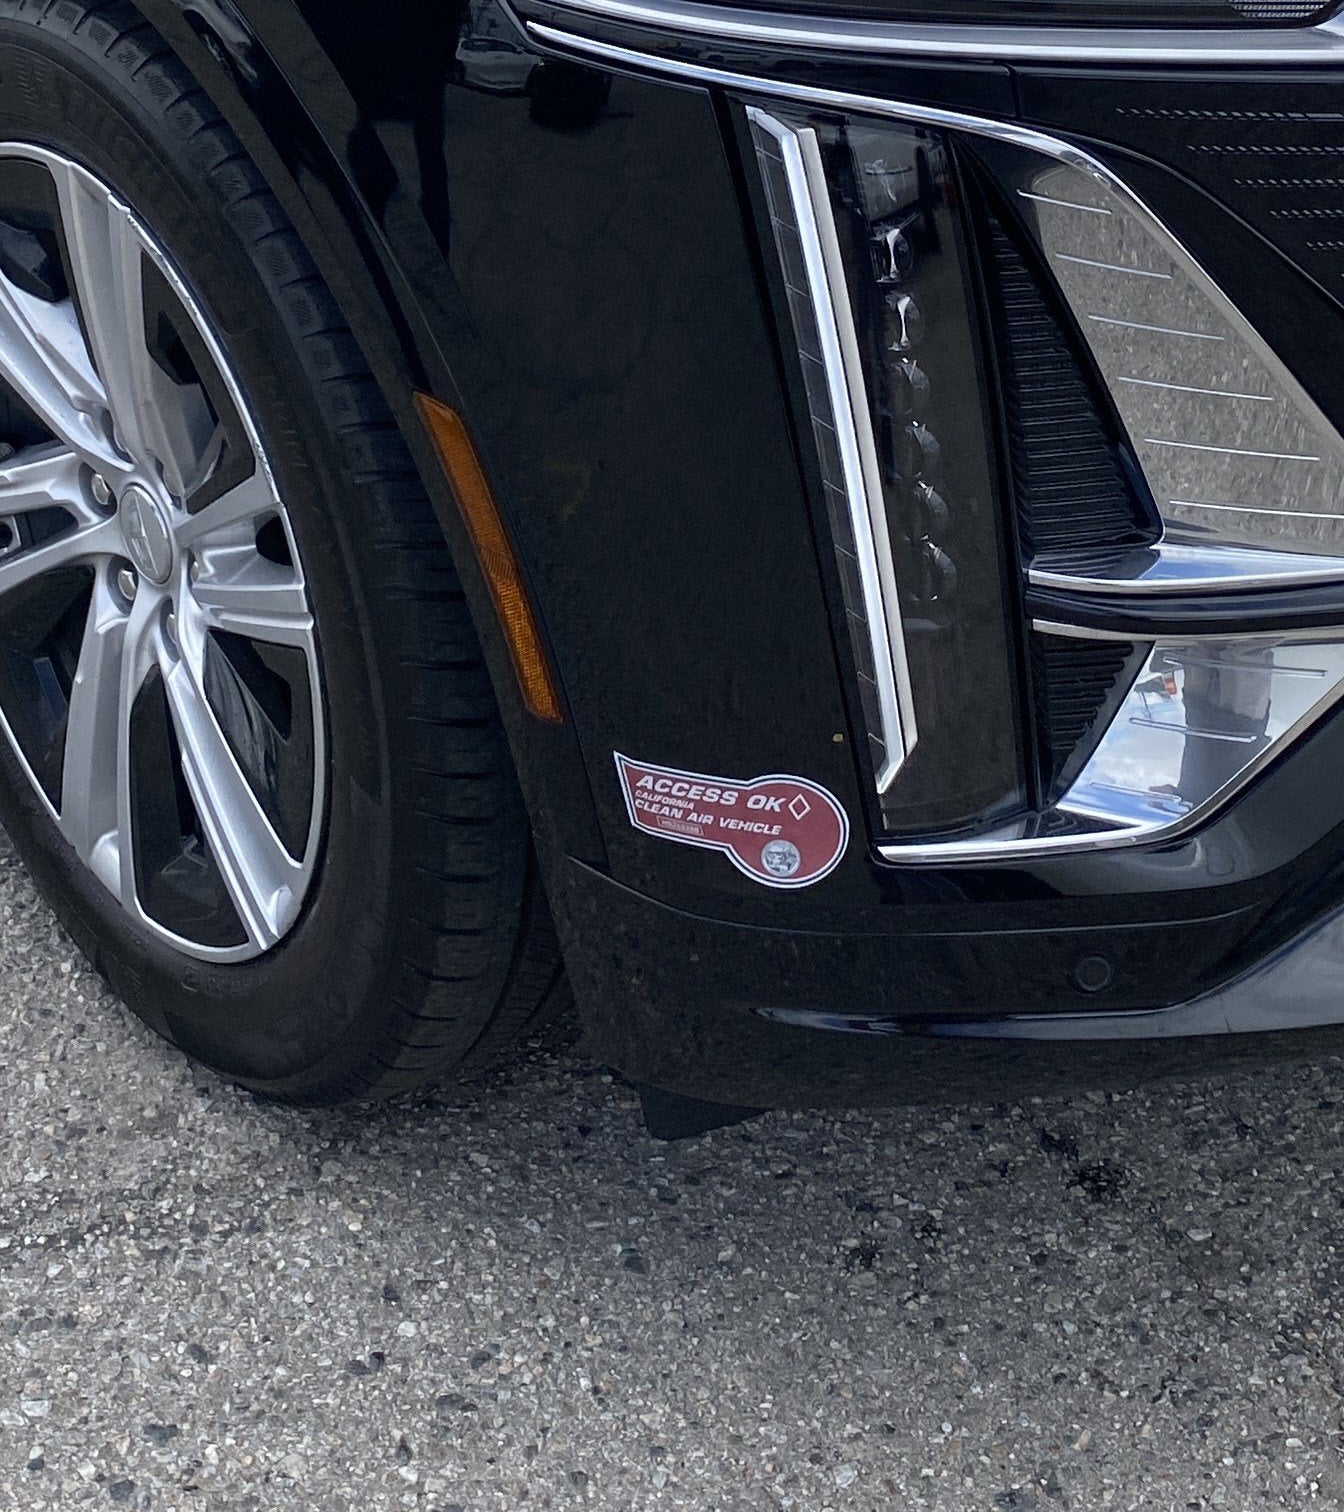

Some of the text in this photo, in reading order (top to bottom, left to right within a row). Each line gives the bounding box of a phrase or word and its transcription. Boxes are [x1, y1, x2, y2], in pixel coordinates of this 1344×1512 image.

[635, 775, 787, 813] ACCESS OK
[635, 789, 695, 810] CALIFORNIA
[635, 798, 684, 819] CLEAN
[686, 812, 714, 825] AIR
[719, 817, 782, 835] VEHICLE
